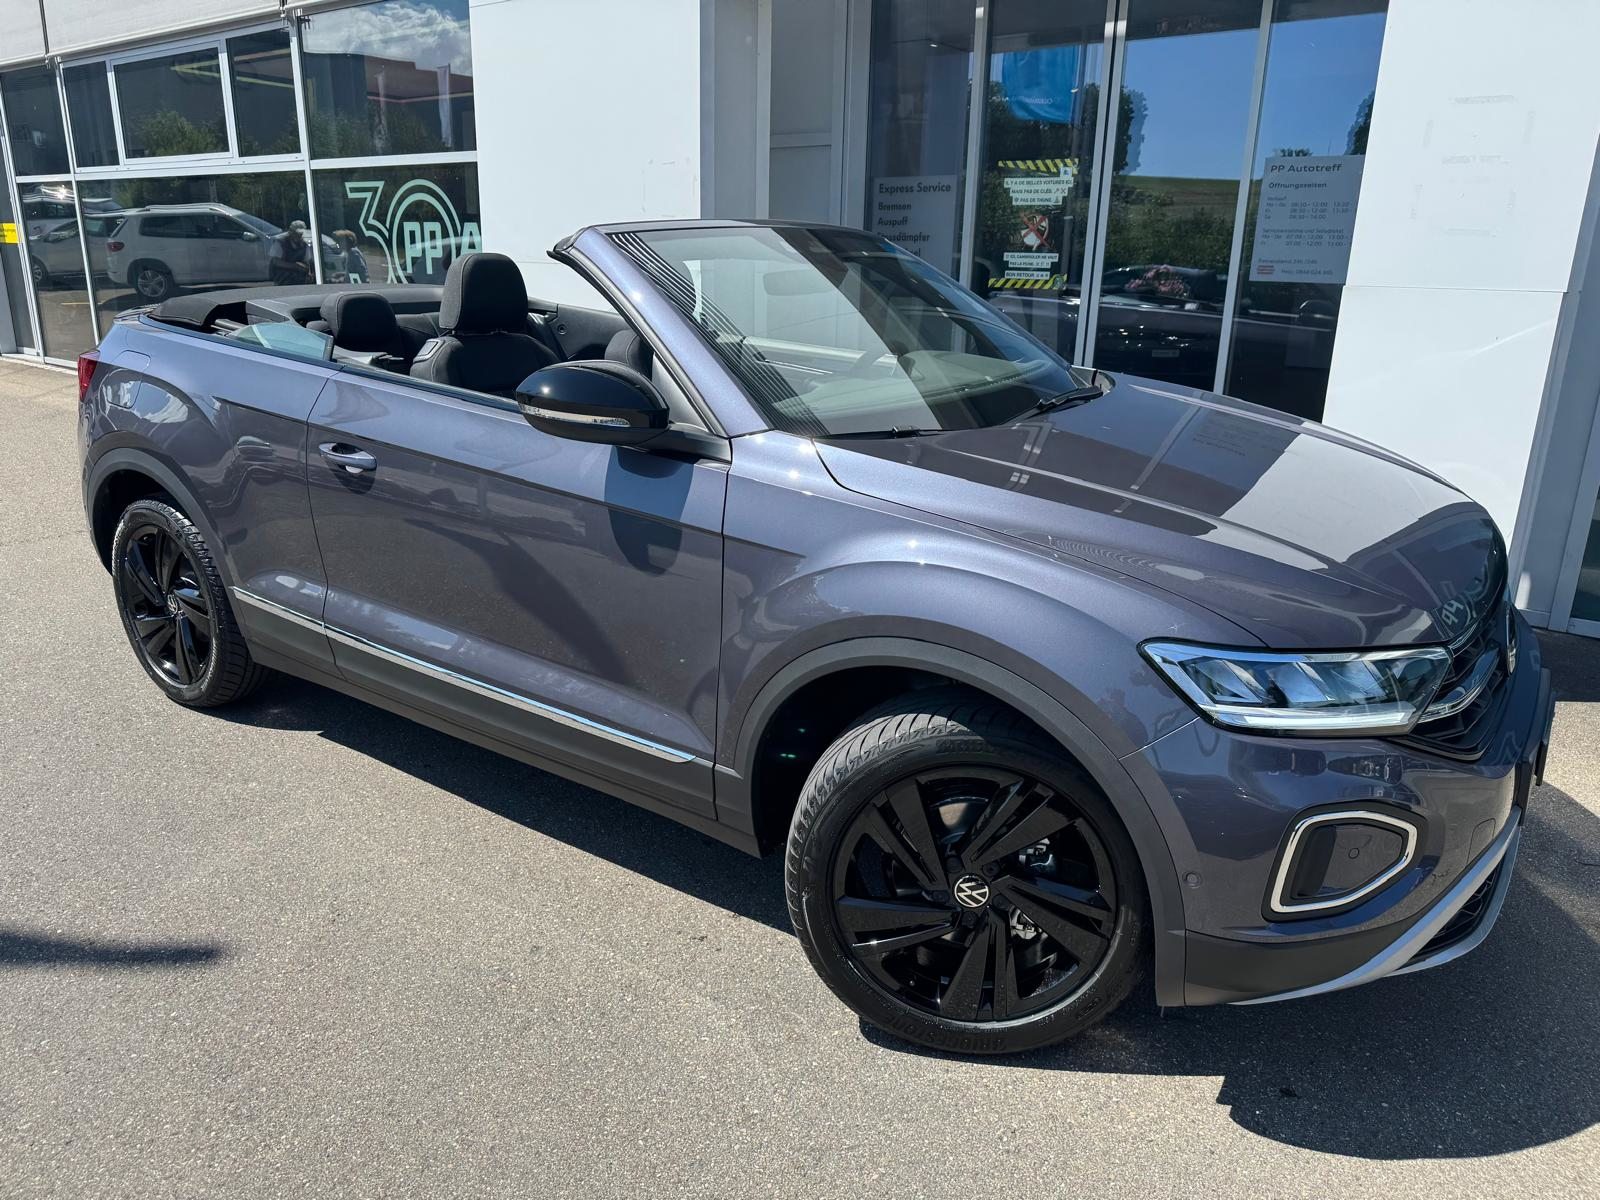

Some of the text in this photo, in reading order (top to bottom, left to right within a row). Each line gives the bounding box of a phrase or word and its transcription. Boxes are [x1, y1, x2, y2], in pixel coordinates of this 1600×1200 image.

[1270, 163, 1343, 173] PP Autotreff
[879, 182, 952, 196] Express Service
[878, 202, 912, 211] Bremsen
[877, 216, 908, 228] Auspuff
[403, 221, 443, 275] PP
